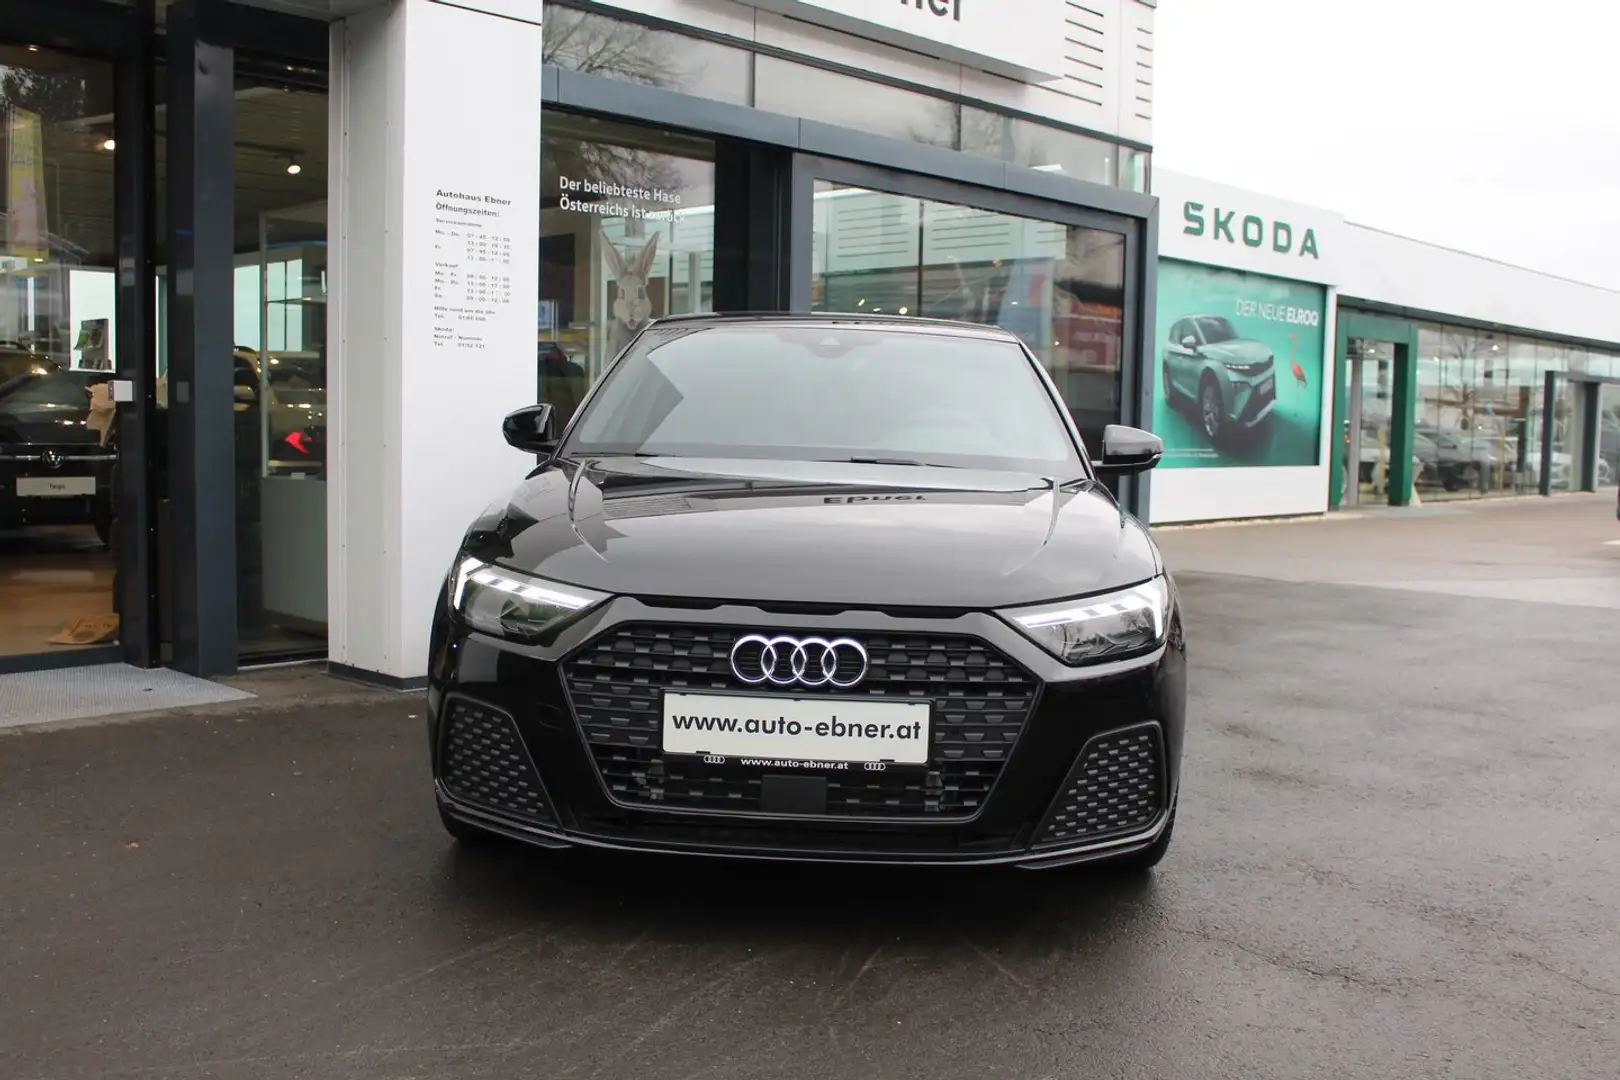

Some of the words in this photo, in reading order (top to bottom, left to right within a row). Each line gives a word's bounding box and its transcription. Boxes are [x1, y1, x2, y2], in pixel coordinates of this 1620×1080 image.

[436, 189, 482, 202] Autohaus
[485, 195, 512, 206] Ebner
[560, 176, 581, 191] Der
[584, 179, 650, 200] beliebteste
[653, 188, 681, 204] Hase
[435, 201, 501, 217] Öffnungszeiten:
[560, 193, 629, 217] Österreichs
[632, 204, 647, 219] ist
[1236, 299, 1258, 317] DER
[1258, 303, 1286, 322] NEUE
[1286, 307, 1320, 328] ELROQ
[672, 714, 922, 740] www.auto-ebner.at
[741, 758, 849, 770] www.auto-ebner.at
